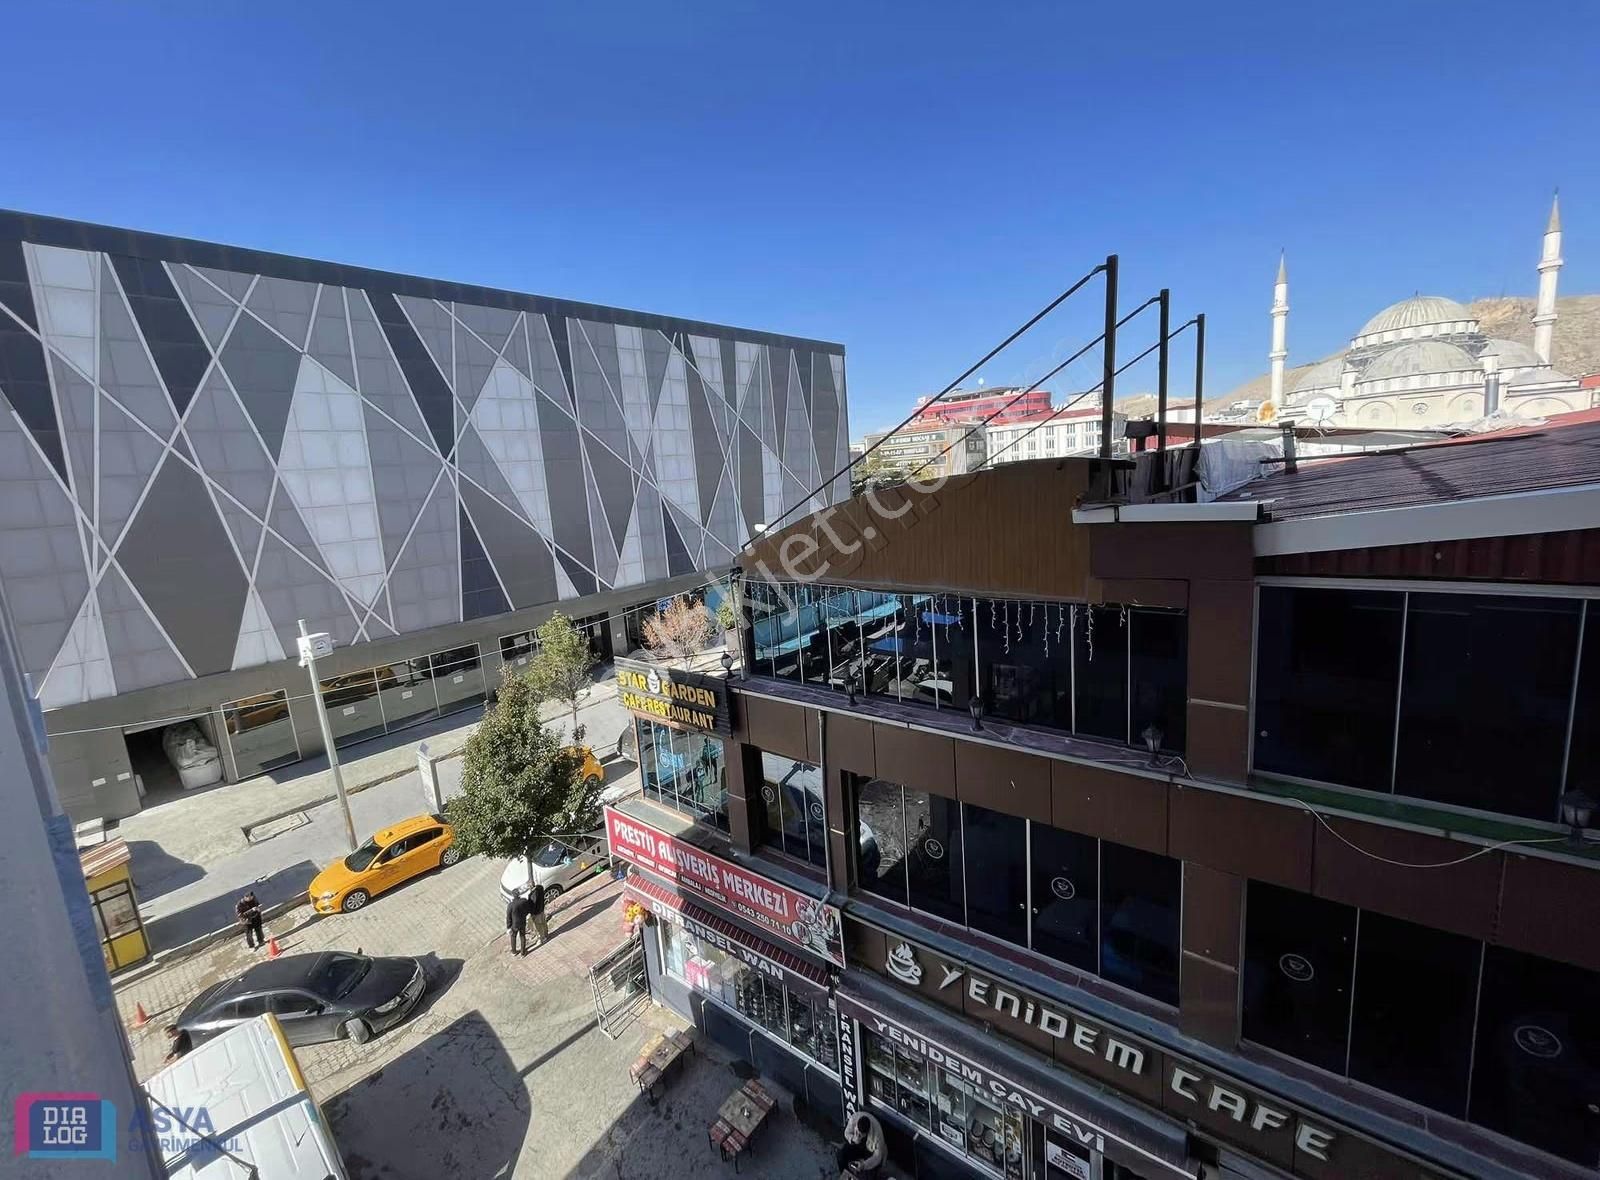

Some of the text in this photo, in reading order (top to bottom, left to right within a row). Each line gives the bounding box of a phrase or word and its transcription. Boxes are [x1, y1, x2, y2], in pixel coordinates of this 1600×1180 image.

[620, 671, 716, 708] STAR GARDEN
[613, 818, 790, 918] PRESTİJ ALIŞVERİŞ MERKEZİ
[742, 951, 784, 981] WAN
[872, 1017, 1105, 1153] YENİDEM ÇAY EVİ
[1170, 1065, 1336, 1162] CAFE
